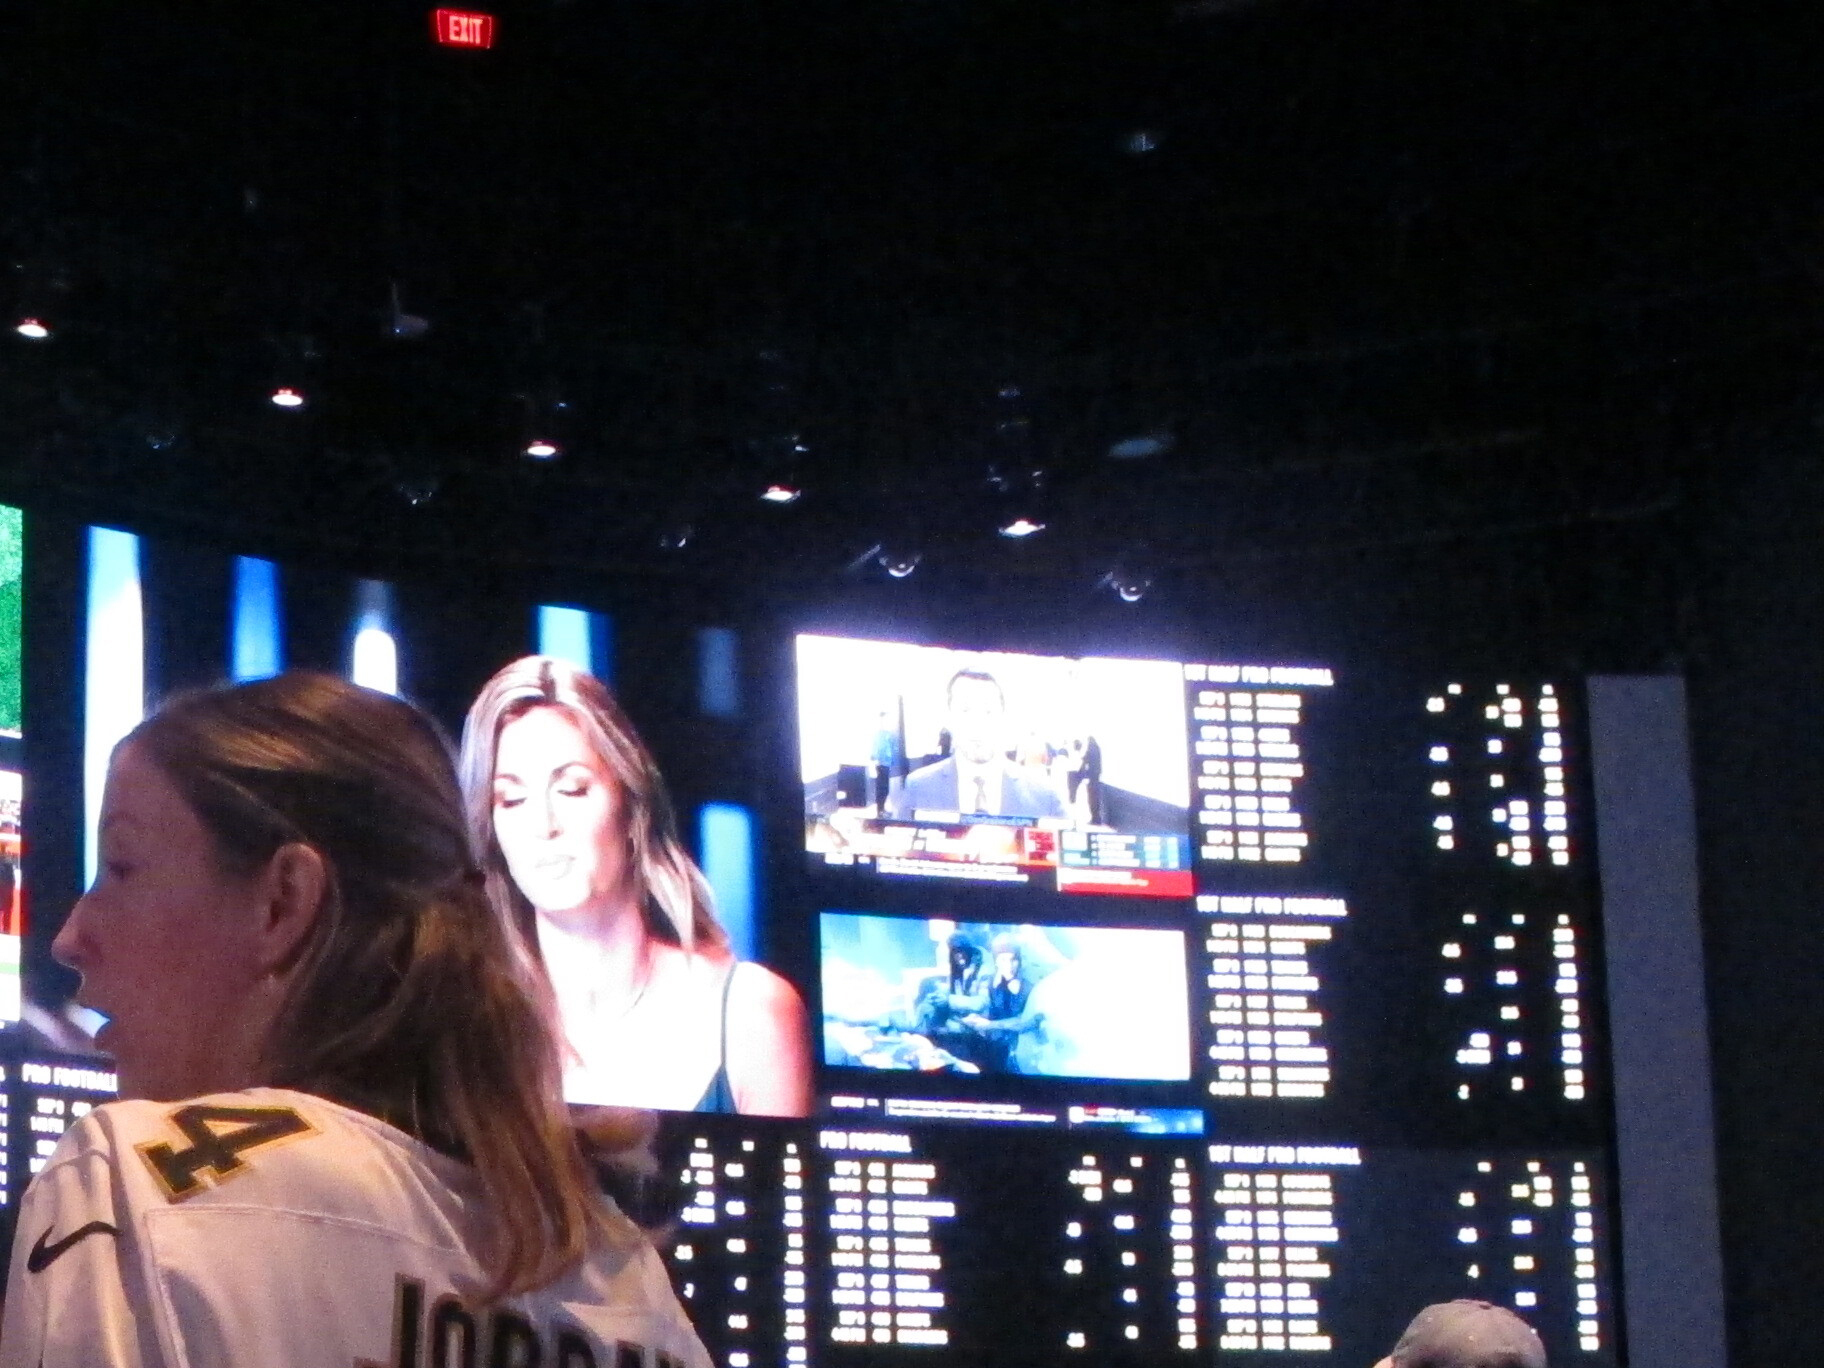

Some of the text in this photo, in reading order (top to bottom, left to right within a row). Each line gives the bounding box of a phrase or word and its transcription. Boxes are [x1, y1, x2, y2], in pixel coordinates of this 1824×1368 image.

[449, 15, 483, 44] EXIT
[22, 1063, 51, 1084] PRO
[54, 1067, 118, 1092] FOOTBALL
